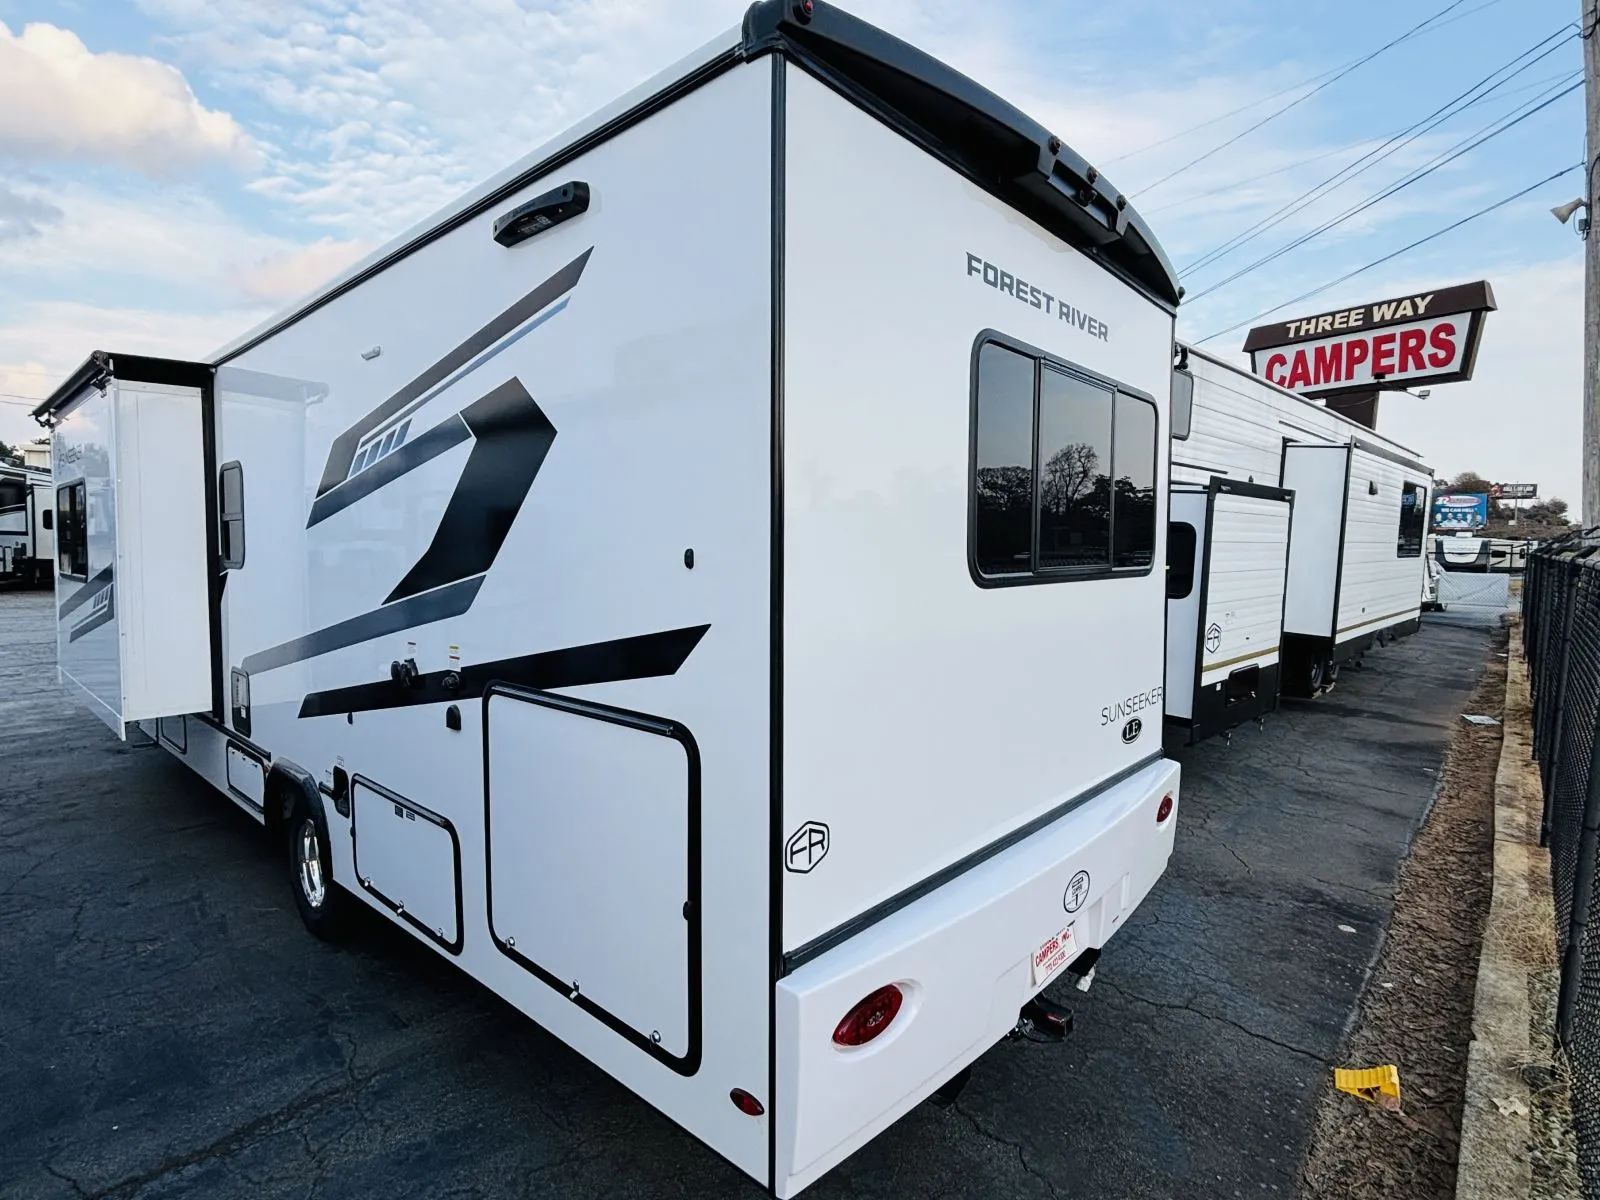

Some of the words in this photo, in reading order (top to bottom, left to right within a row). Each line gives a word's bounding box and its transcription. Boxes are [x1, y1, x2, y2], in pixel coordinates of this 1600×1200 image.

[966, 251, 1055, 314] FOREST
[1058, 300, 1109, 343] RIVER
[1286, 309, 1364, 338] THREE
[1372, 294, 1434, 323] WAY
[1265, 322, 1457, 389] CAMPERS
[1101, 686, 1163, 726] SUNSEEKER
[1124, 719, 1141, 739] LE
